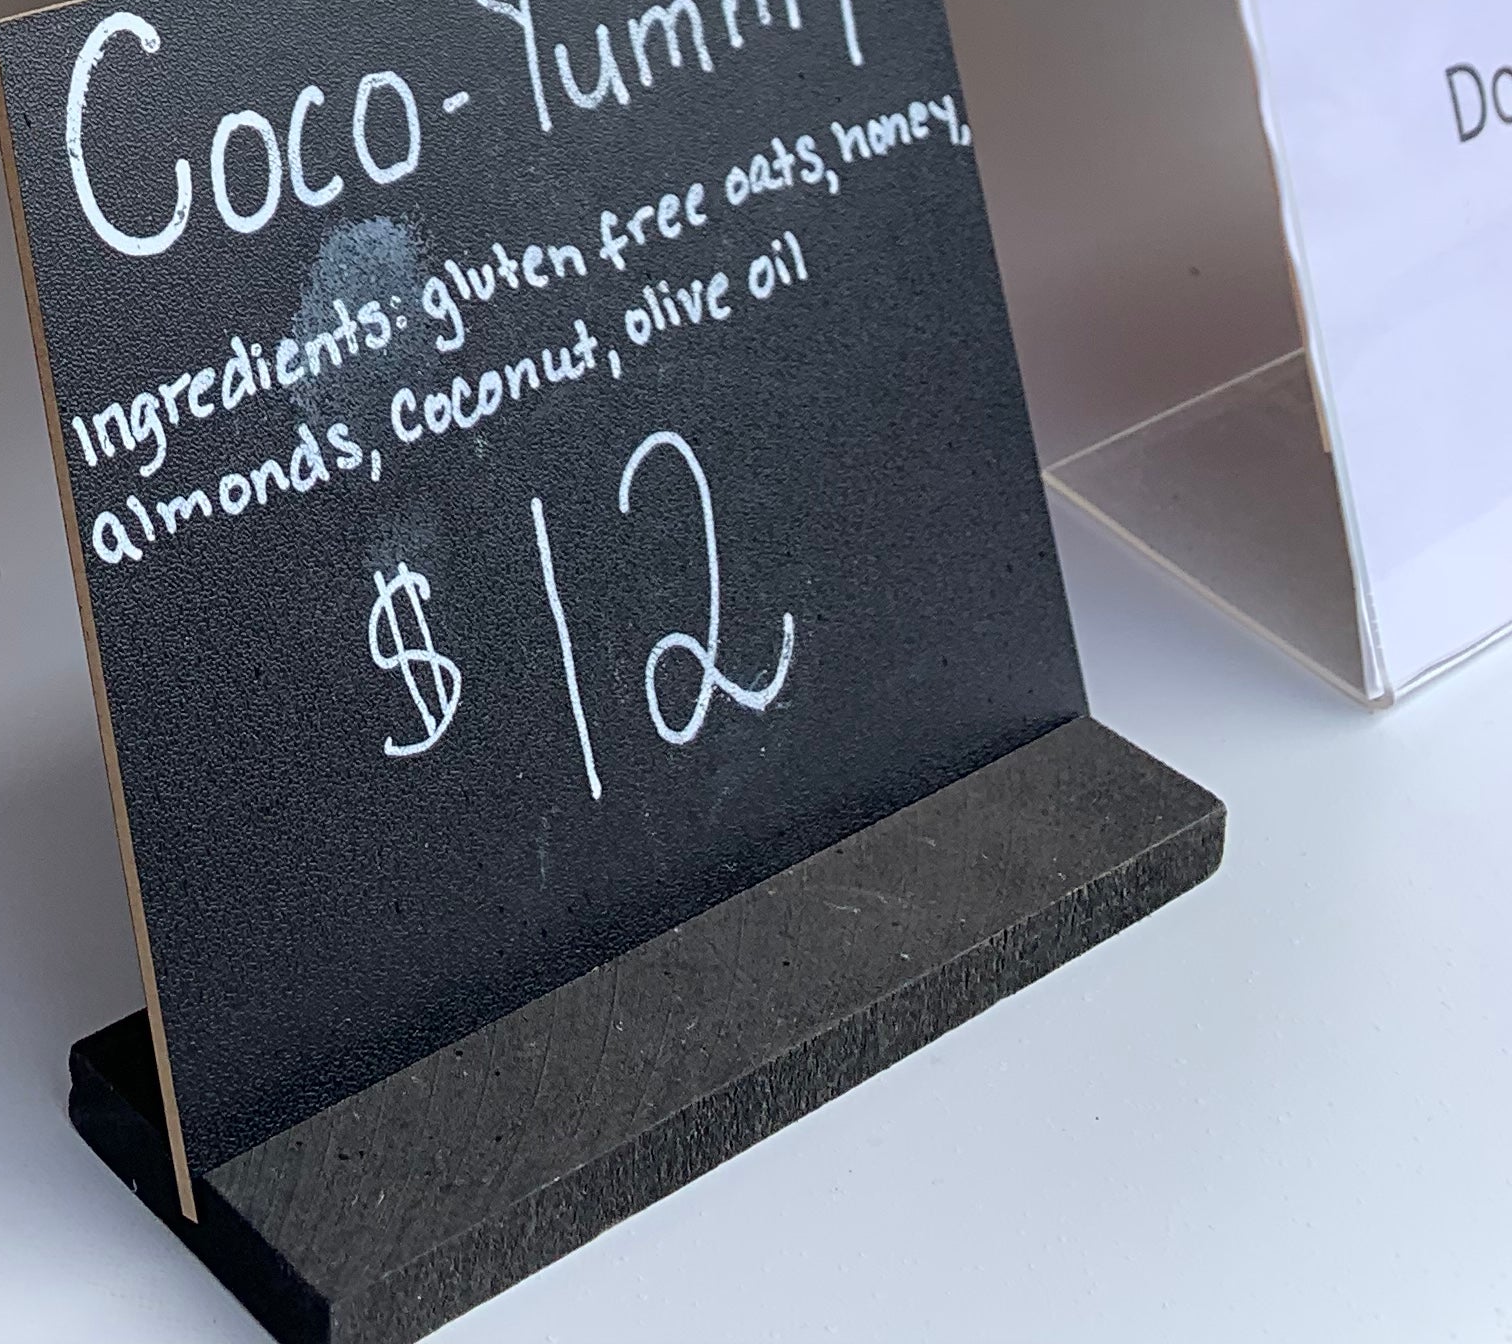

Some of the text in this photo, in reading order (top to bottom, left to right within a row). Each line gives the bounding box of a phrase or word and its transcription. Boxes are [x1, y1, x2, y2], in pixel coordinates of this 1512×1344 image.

[72, 292, 408, 477] Ingredients:
[422, 242, 588, 352] gluten
[600, 182, 707, 271] free
[92, 230, 809, 564] almonds, coconut, olive oil
